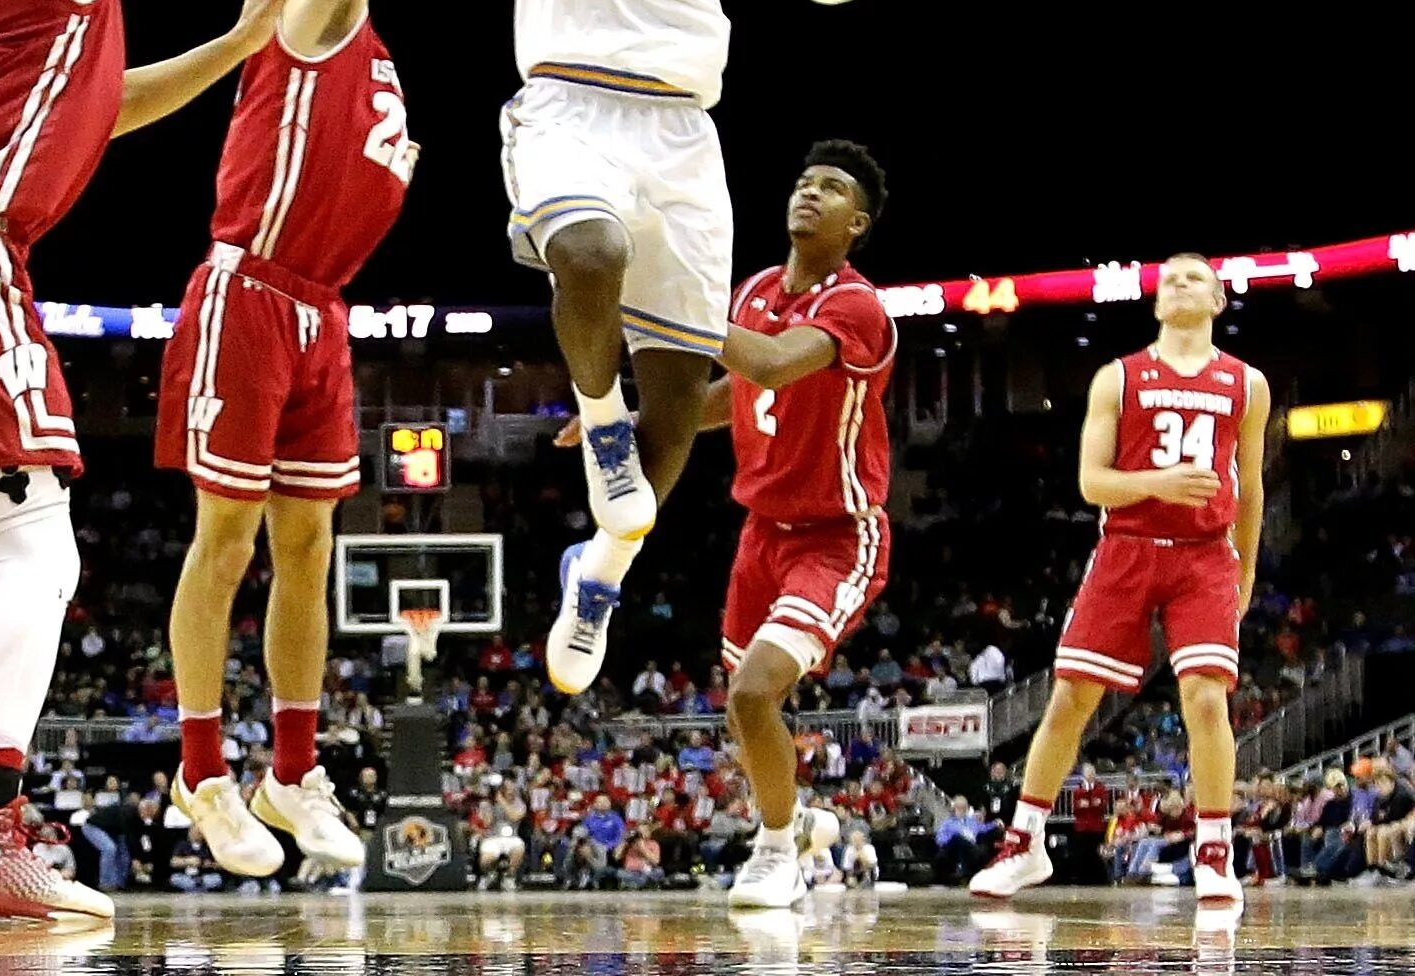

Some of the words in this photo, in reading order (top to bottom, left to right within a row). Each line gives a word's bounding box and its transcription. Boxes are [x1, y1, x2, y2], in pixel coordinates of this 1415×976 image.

[963, 278, 1019, 315] 44
[1137, 389, 1233, 417] WISCONSIN
[1150, 410, 1217, 470] 34
[907, 715, 981, 735] ESPN
